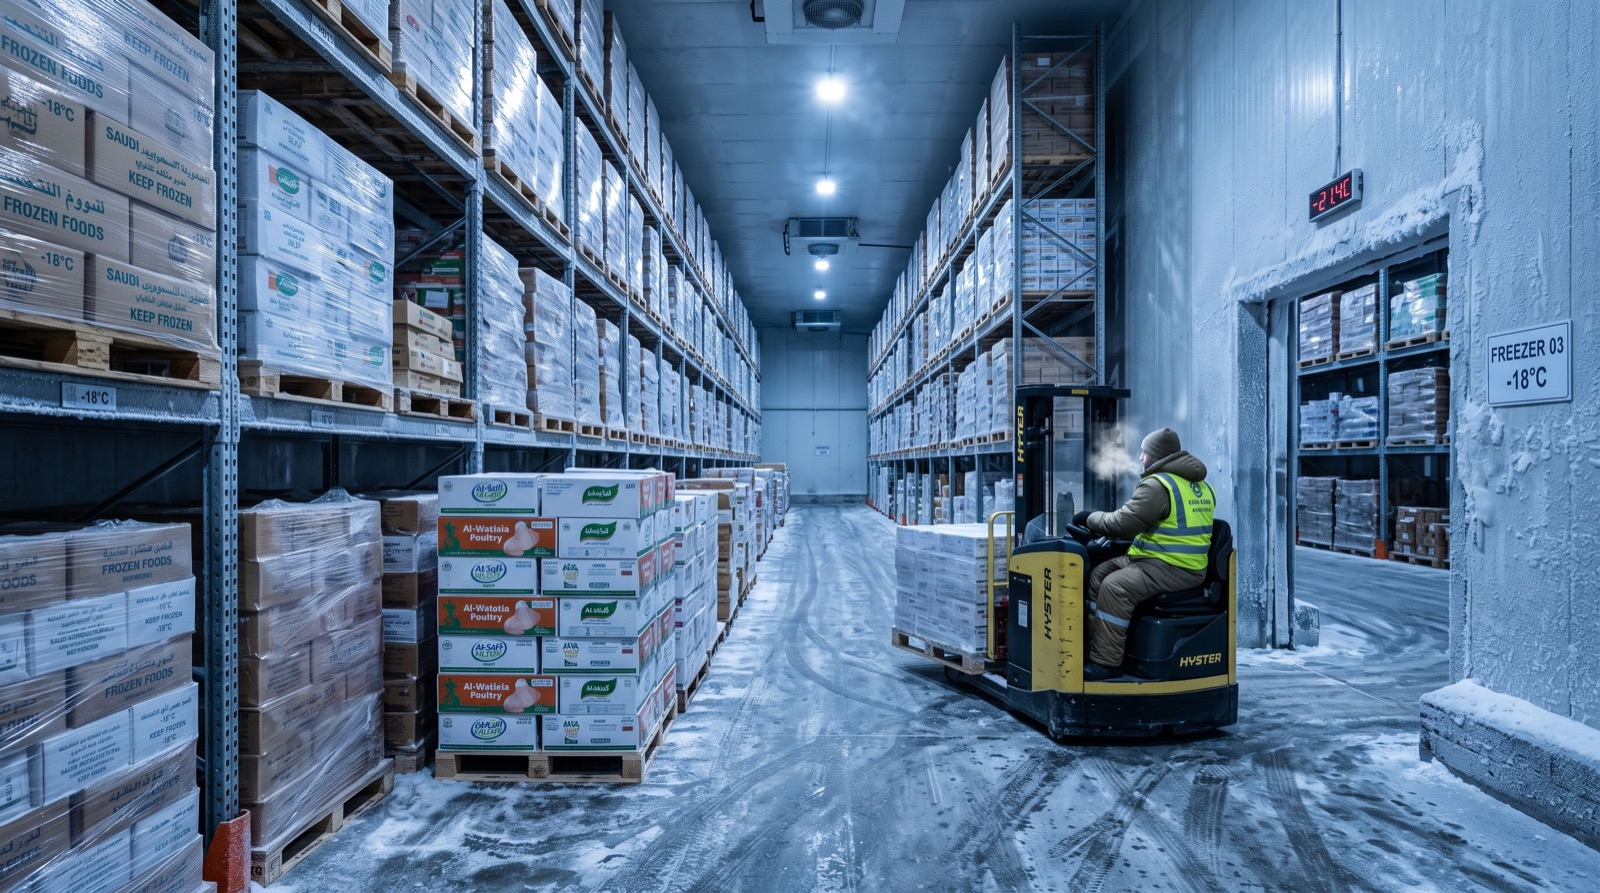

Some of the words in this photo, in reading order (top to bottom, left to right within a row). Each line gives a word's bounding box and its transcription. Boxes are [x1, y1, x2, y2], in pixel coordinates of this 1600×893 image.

[2, 34, 57, 76] FROZEN
[61, 65, 103, 99] FOODS
[154, 50, 189, 83] FROZEN
[41, 98, 74, 122] -18°C
[106, 126, 139, 152] SAUDI
[128, 170, 154, 191] KEEP
[156, 182, 192, 208] FROZEN
[4, 195, 58, 227] FROZEN
[62, 215, 104, 240] FOODS
[41, 252, 74, 271] -18°C
[106, 267, 139, 288] SAUDI
[130, 307, 155, 323] KEEP
[158, 313, 193, 332] FROZEN
[1491, 339, 1546, 364] FREEZER
[1549, 336, 1564, 355] 03
[1506, 366, 1547, 390] -18°C
[81, 390, 109, 405] -18°C
[470, 534, 502, 543] Poultry
[102, 560, 140, 575] FROZEN
[142, 555, 173, 569] FOODS
[1, 574, 37, 590] OODS
[1044, 567, 1052, 640] HYSTER
[145, 616, 161, 625] KEEP
[161, 611, 183, 621] FROZEN
[156, 622, 173, 633] -18°C
[470, 613, 503, 623] Poultry
[1179, 652, 1222, 667] HYSTER
[105, 677, 142, 698] FROZEN
[144, 667, 173, 685] FOODS
[470, 692, 502, 701] Poultry
[149, 728, 165, 740] KEEP
